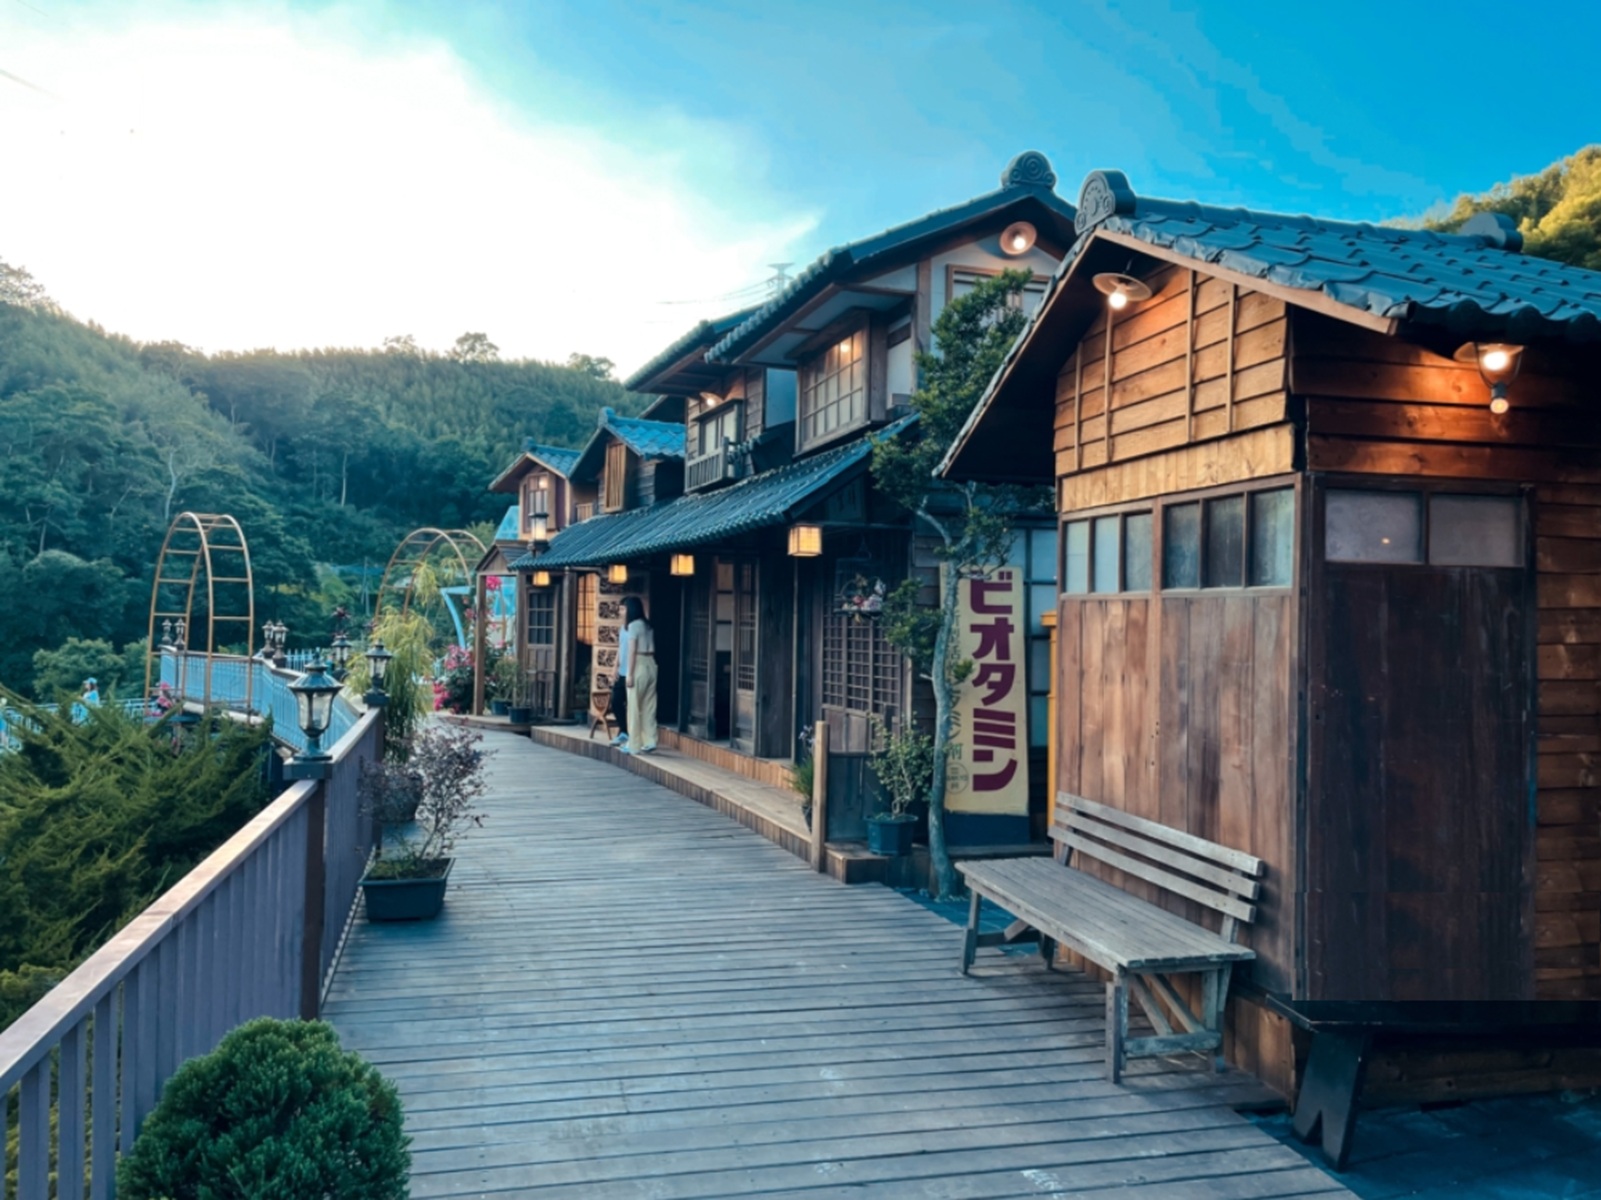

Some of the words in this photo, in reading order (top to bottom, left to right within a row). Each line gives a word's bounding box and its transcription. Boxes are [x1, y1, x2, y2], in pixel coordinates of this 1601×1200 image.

[969, 570, 1018, 792] ビオタミン
